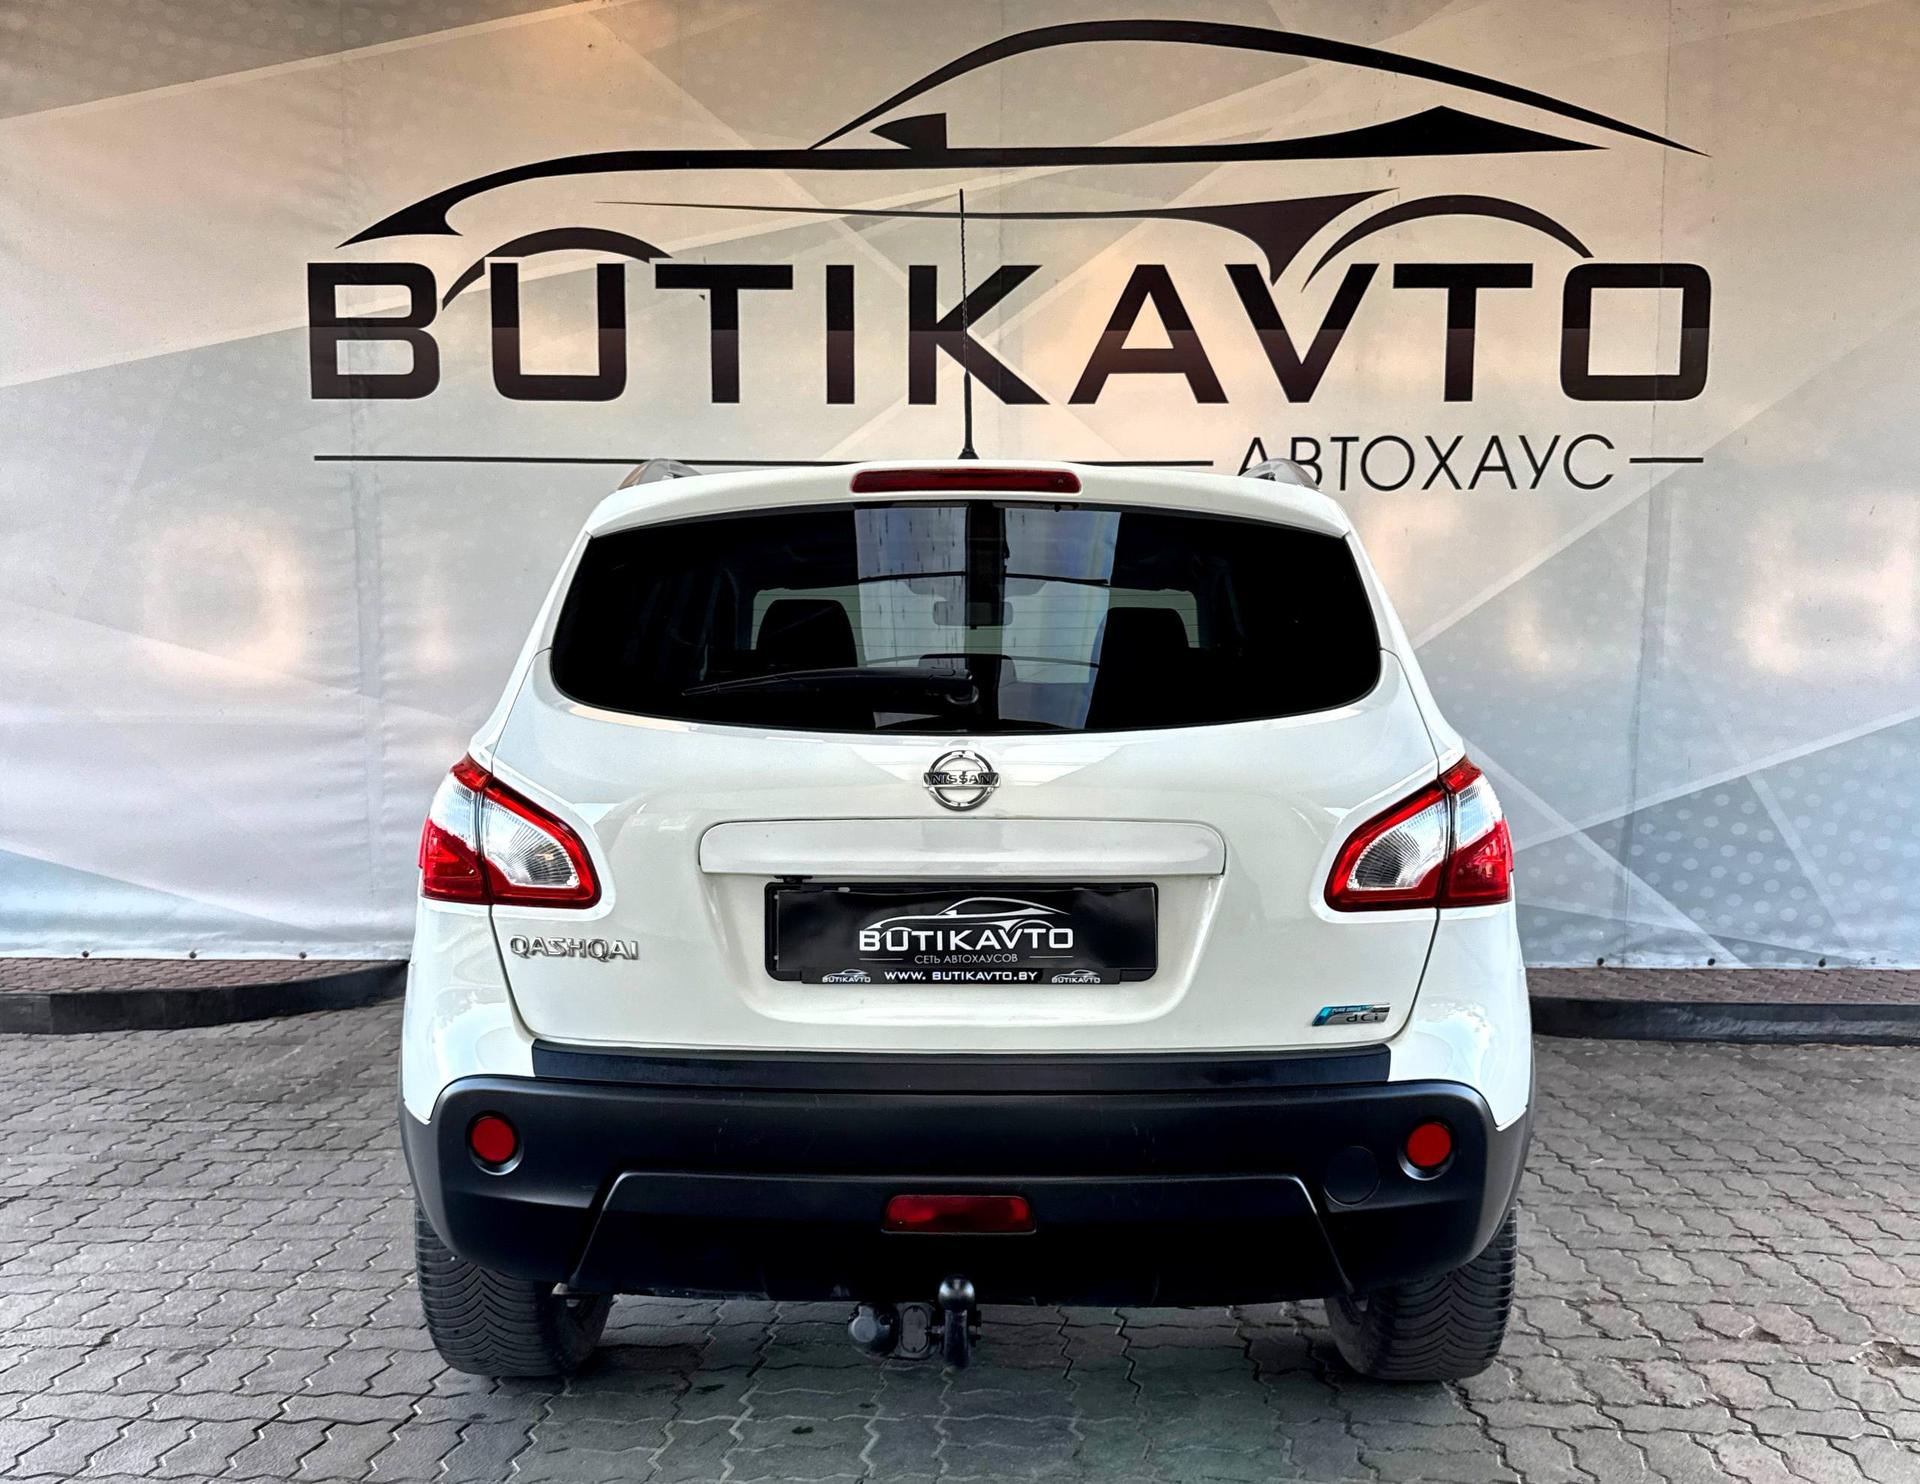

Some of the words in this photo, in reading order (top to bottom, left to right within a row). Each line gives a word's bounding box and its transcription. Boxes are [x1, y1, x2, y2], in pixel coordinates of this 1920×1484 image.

[307, 261, 1712, 405] BUTIKAVTO
[1237, 433, 1616, 491] АВТОХАУС
[931, 774, 992, 785] NISSAN
[510, 935, 639, 962] QASHQAI
[858, 928, 1074, 951] BUTIKAVTO
[914, 955, 941, 965] СЕТЬ
[943, 953, 1018, 964] АВТОХАУСОВ
[884, 971, 926, 980] WWW.
[932, 970, 1038, 981] BUTIKAVTO.BY
